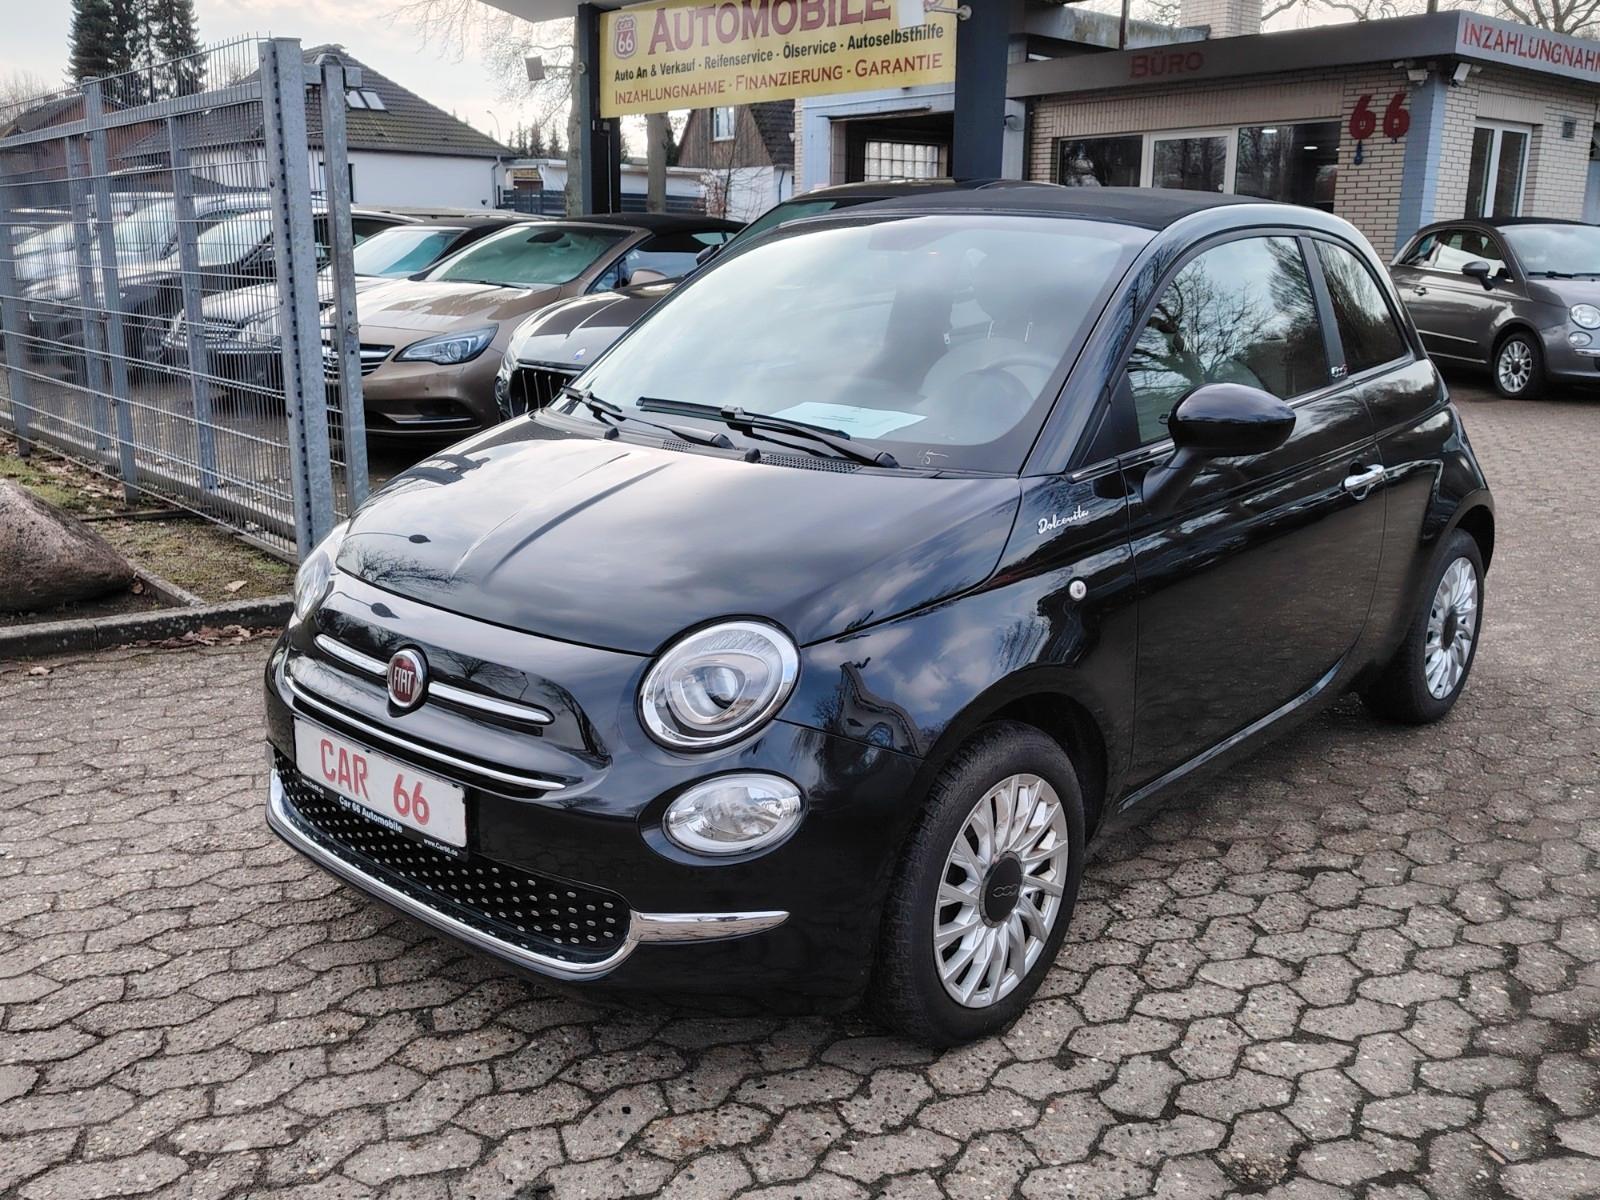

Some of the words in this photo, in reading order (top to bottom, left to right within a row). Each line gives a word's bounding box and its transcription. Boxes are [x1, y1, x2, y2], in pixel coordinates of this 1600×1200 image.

[618, 32, 634, 53] 66
[648, 0, 891, 55] AUTOMOBILE
[615, 69, 634, 81] Auto
[636, 66, 648, 79] An
[650, 64, 657, 76] &
[660, 58, 696, 75] Verkauf
[704, 48, 773, 69] Reifenservice
[783, 41, 837, 59] Ölservice
[847, 23, 944, 50] Autoselbsthilfe
[1130, 50, 1204, 78] BÜRO
[615, 80, 726, 104] INZAHLUNGNAHME
[735, 65, 843, 91] FINANZIERUNG
[855, 52, 943, 77] GARANTIE
[1349, 92, 1410, 140] 66
[394, 666, 414, 695] FIAT
[320, 739, 370, 801] CAR
[393, 773, 430, 826] 66
[339, 795, 351, 809] Car
[352, 802, 361, 814] 66
[361, 807, 403, 833] Automobile
